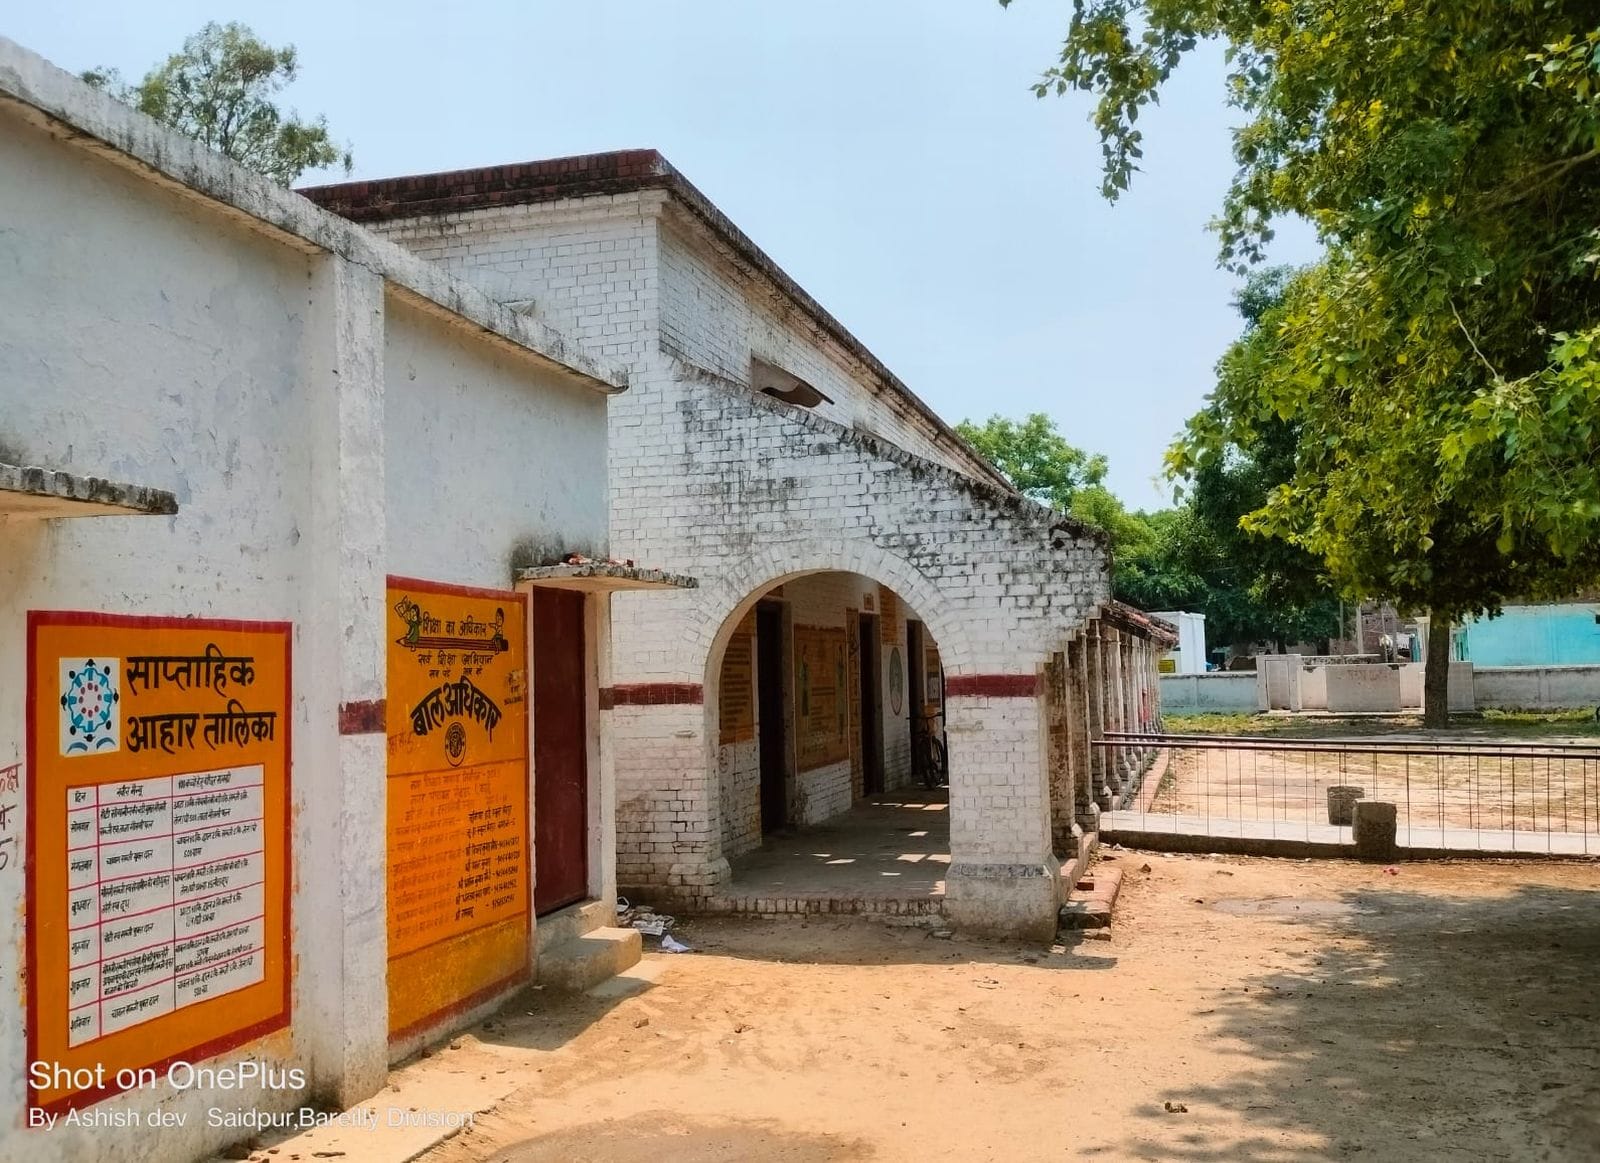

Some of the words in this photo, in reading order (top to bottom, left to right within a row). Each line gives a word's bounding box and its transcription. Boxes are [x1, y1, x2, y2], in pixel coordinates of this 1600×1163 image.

[445, 620, 455, 636] का
[126, 643, 255, 697] साप्ताहिक
[126, 712, 200, 754] आहार
[203, 699, 277, 750] तालिका
[410, 685, 444, 736] बाल
